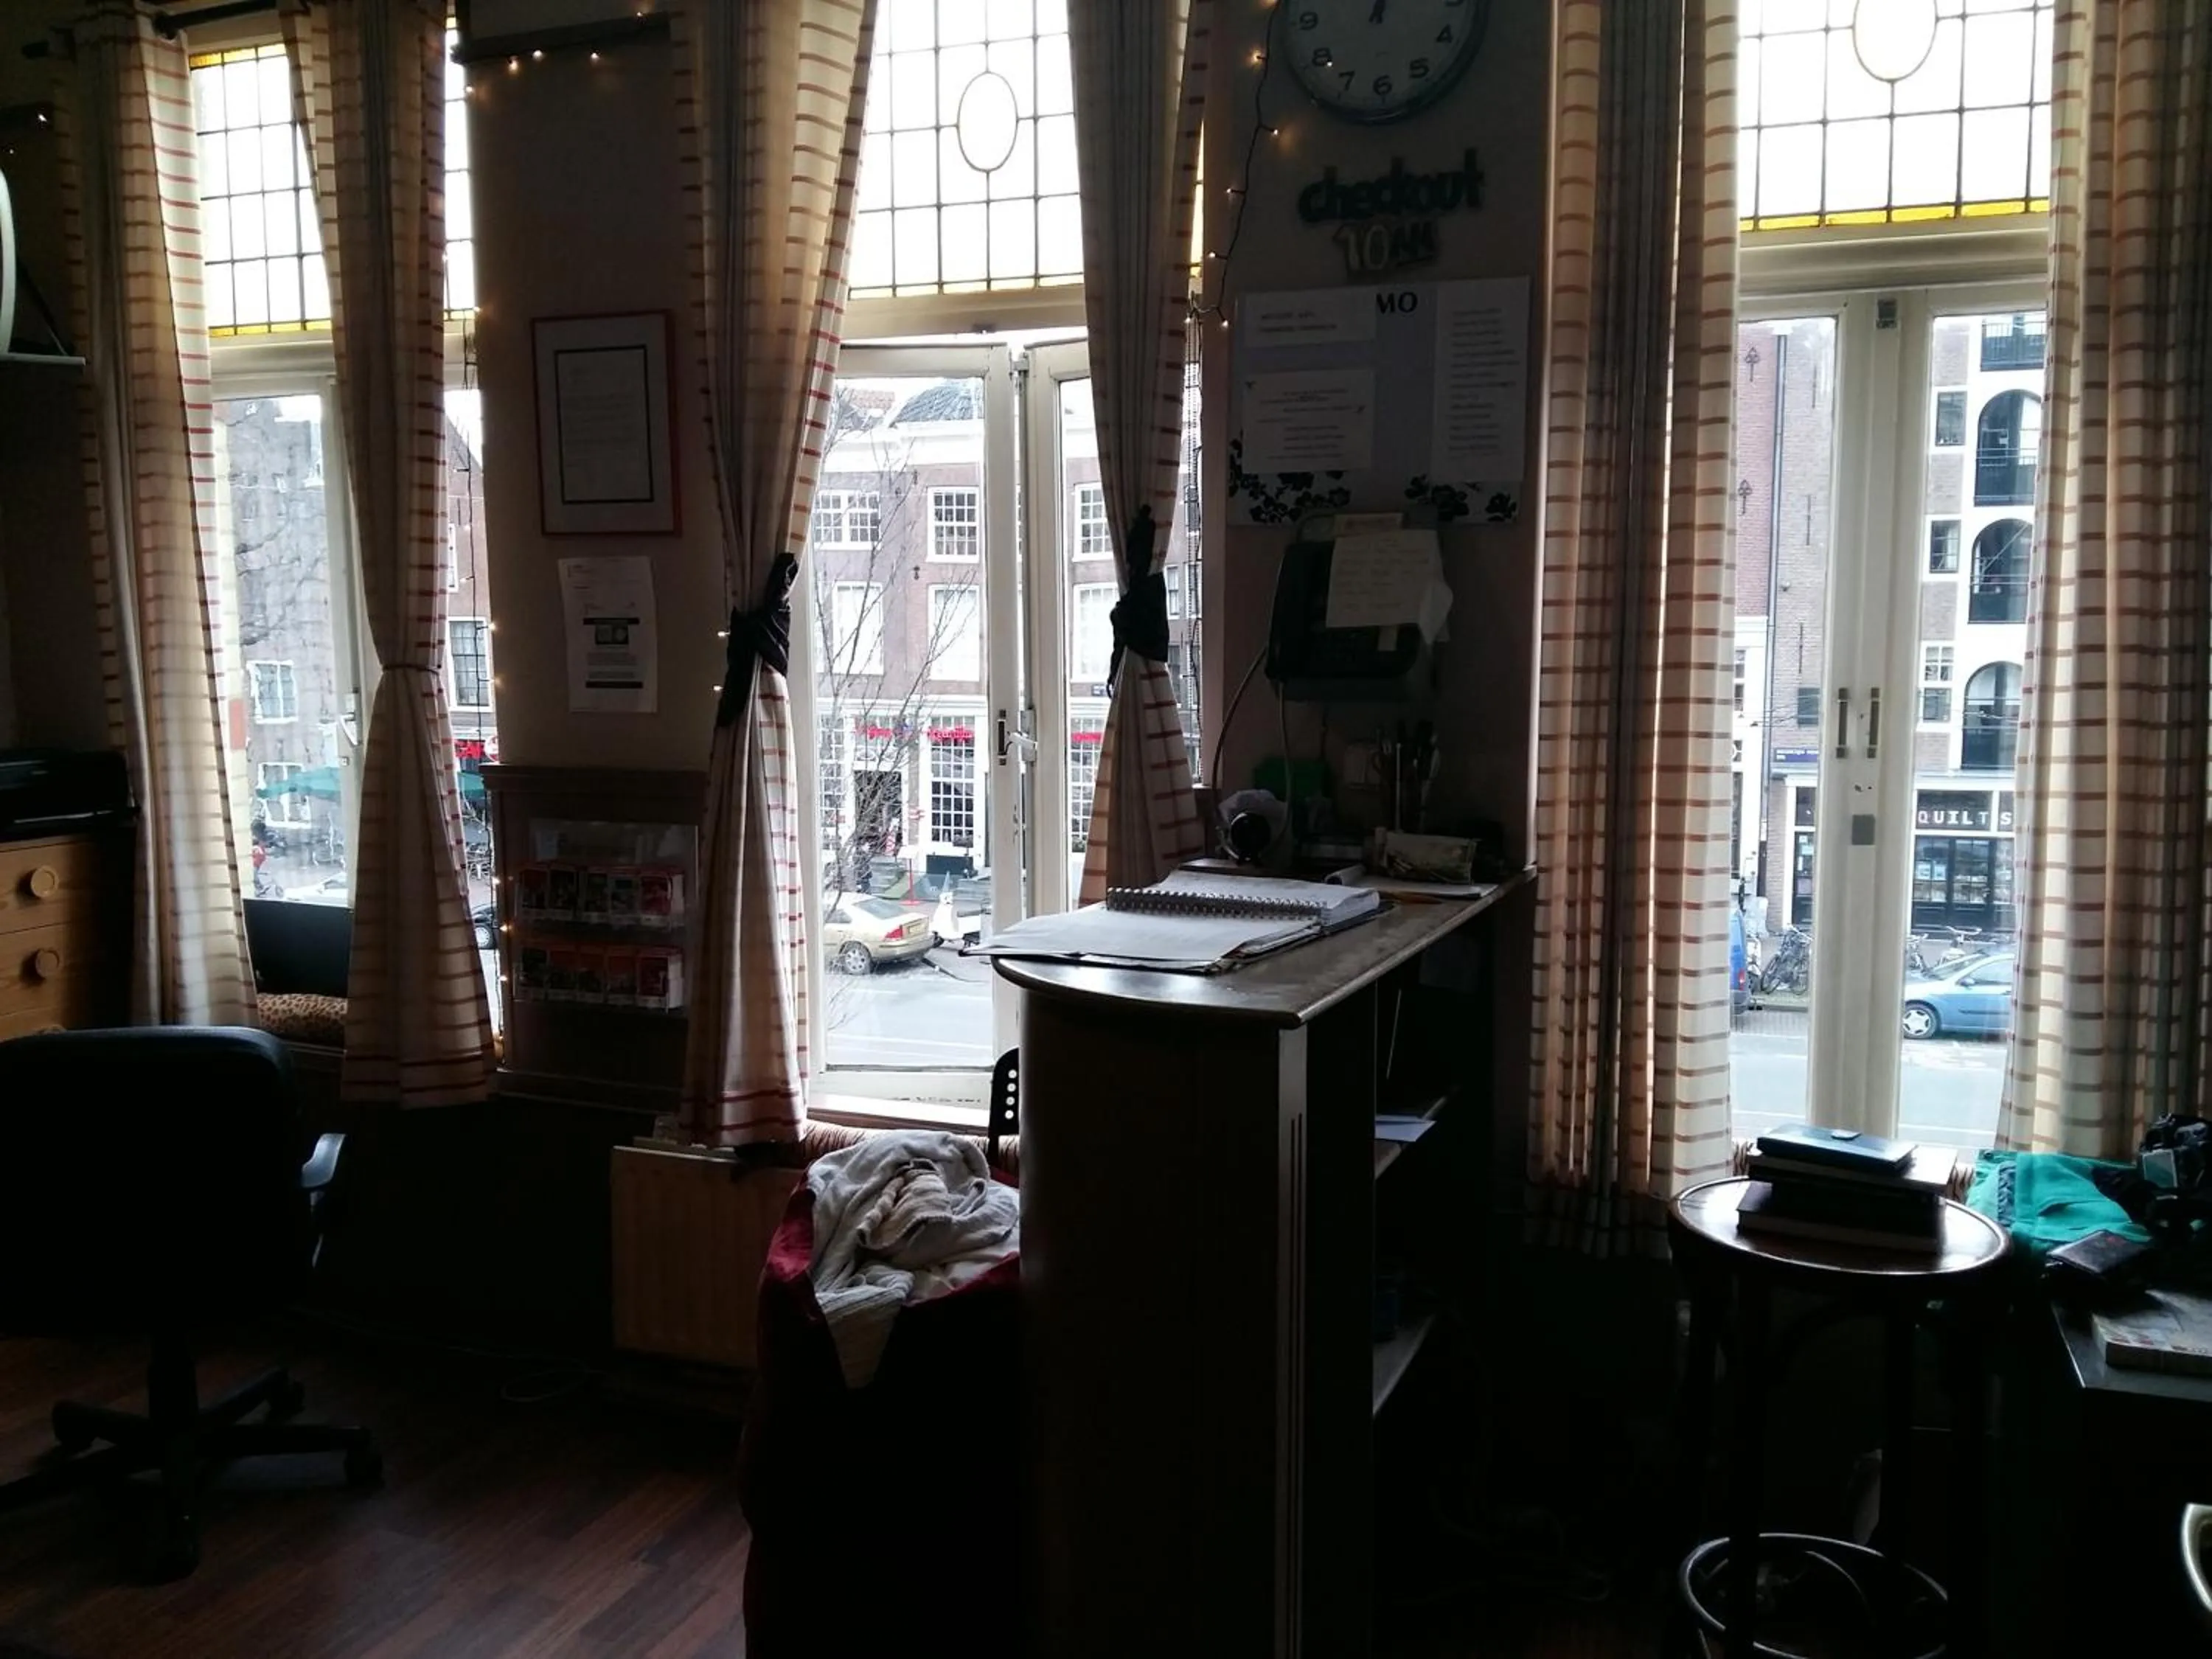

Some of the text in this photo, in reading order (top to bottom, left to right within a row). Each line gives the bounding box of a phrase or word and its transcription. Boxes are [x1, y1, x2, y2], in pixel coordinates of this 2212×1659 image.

[1299, 11, 1318, 30] 9
[1436, 24, 1453, 43] 4
[1312, 47, 1332, 66] 8
[1409, 57, 1429, 78] 5
[1338, 71, 1355, 91] 7
[1373, 75, 1392, 95] 6
[1298, 147, 1485, 223] checkout
[1333, 224, 1391, 271] 10
[1917, 810, 2012, 826] QUILTS
